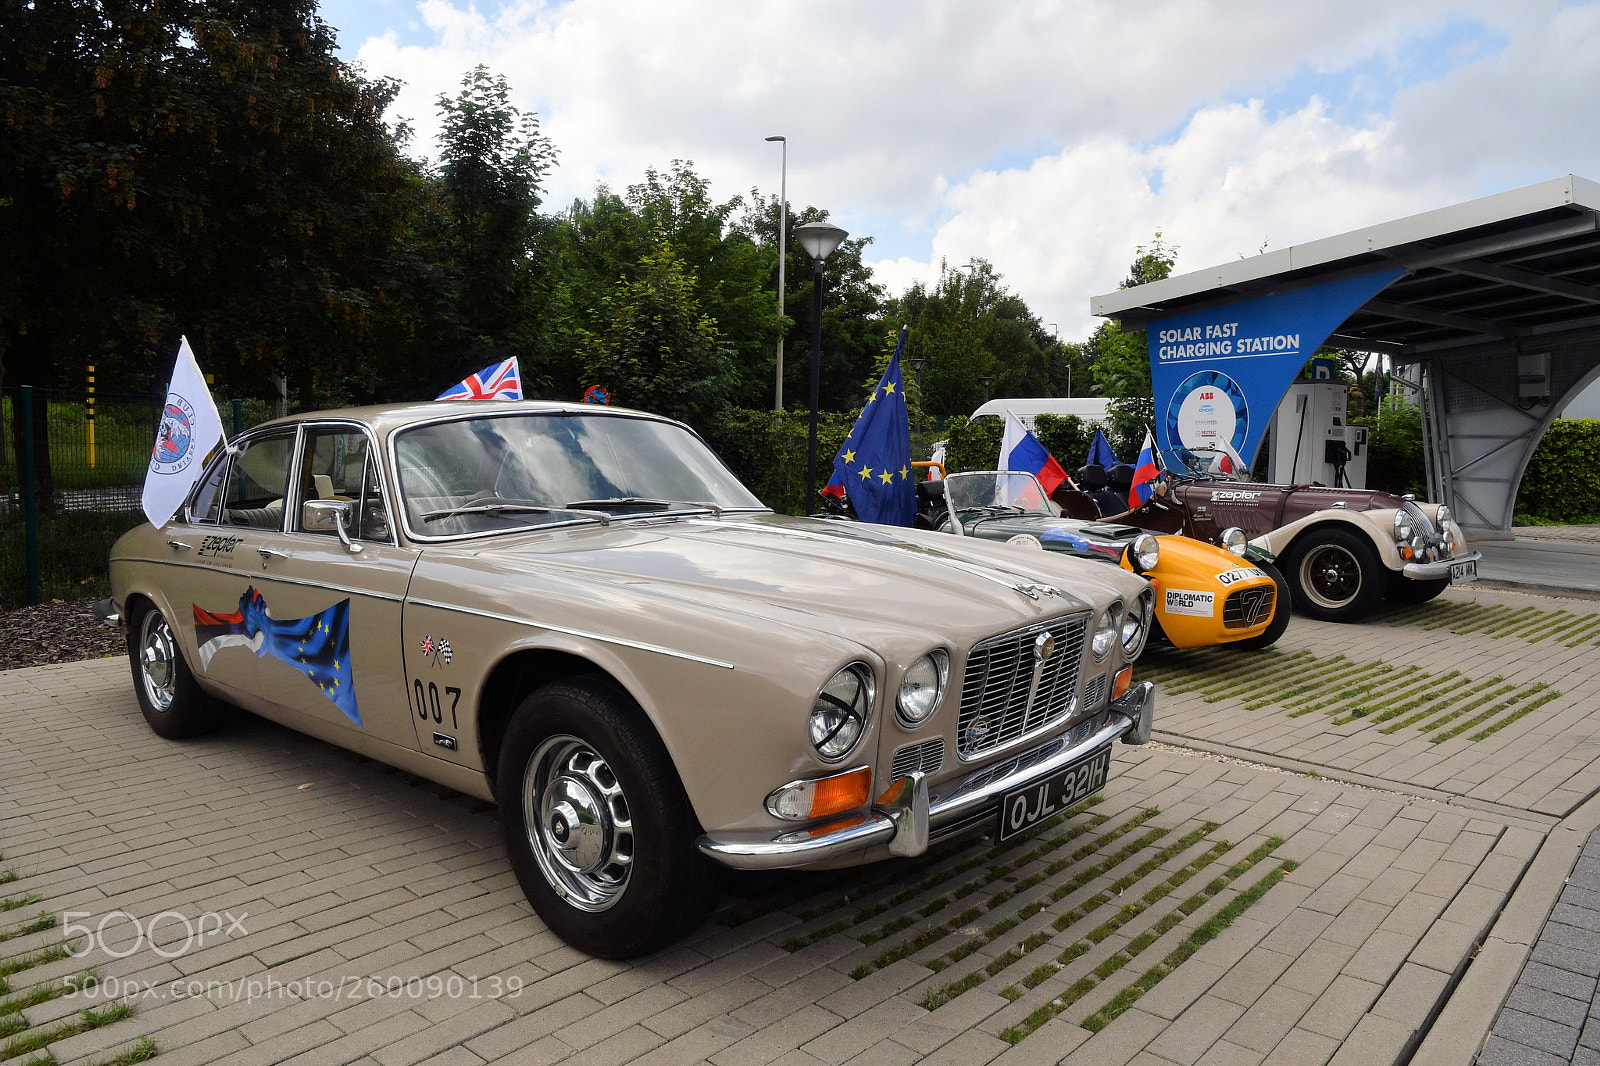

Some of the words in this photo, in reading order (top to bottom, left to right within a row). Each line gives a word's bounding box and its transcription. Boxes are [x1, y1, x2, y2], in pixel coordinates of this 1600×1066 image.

[1159, 327, 1201, 343] SOLAR
[1206, 323, 1238, 339] FAST
[1159, 340, 1232, 360] CHARGING
[1236, 334, 1299, 353] STATION
[1199, 392, 1214, 400] ABB
[1219, 490, 1262, 502] zepter
[1166, 591, 1213, 603] DIPLOMATIC
[414, 678, 461, 730] 007
[1011, 783, 1055, 830] OJL
[1061, 754, 1106, 804] 321H
